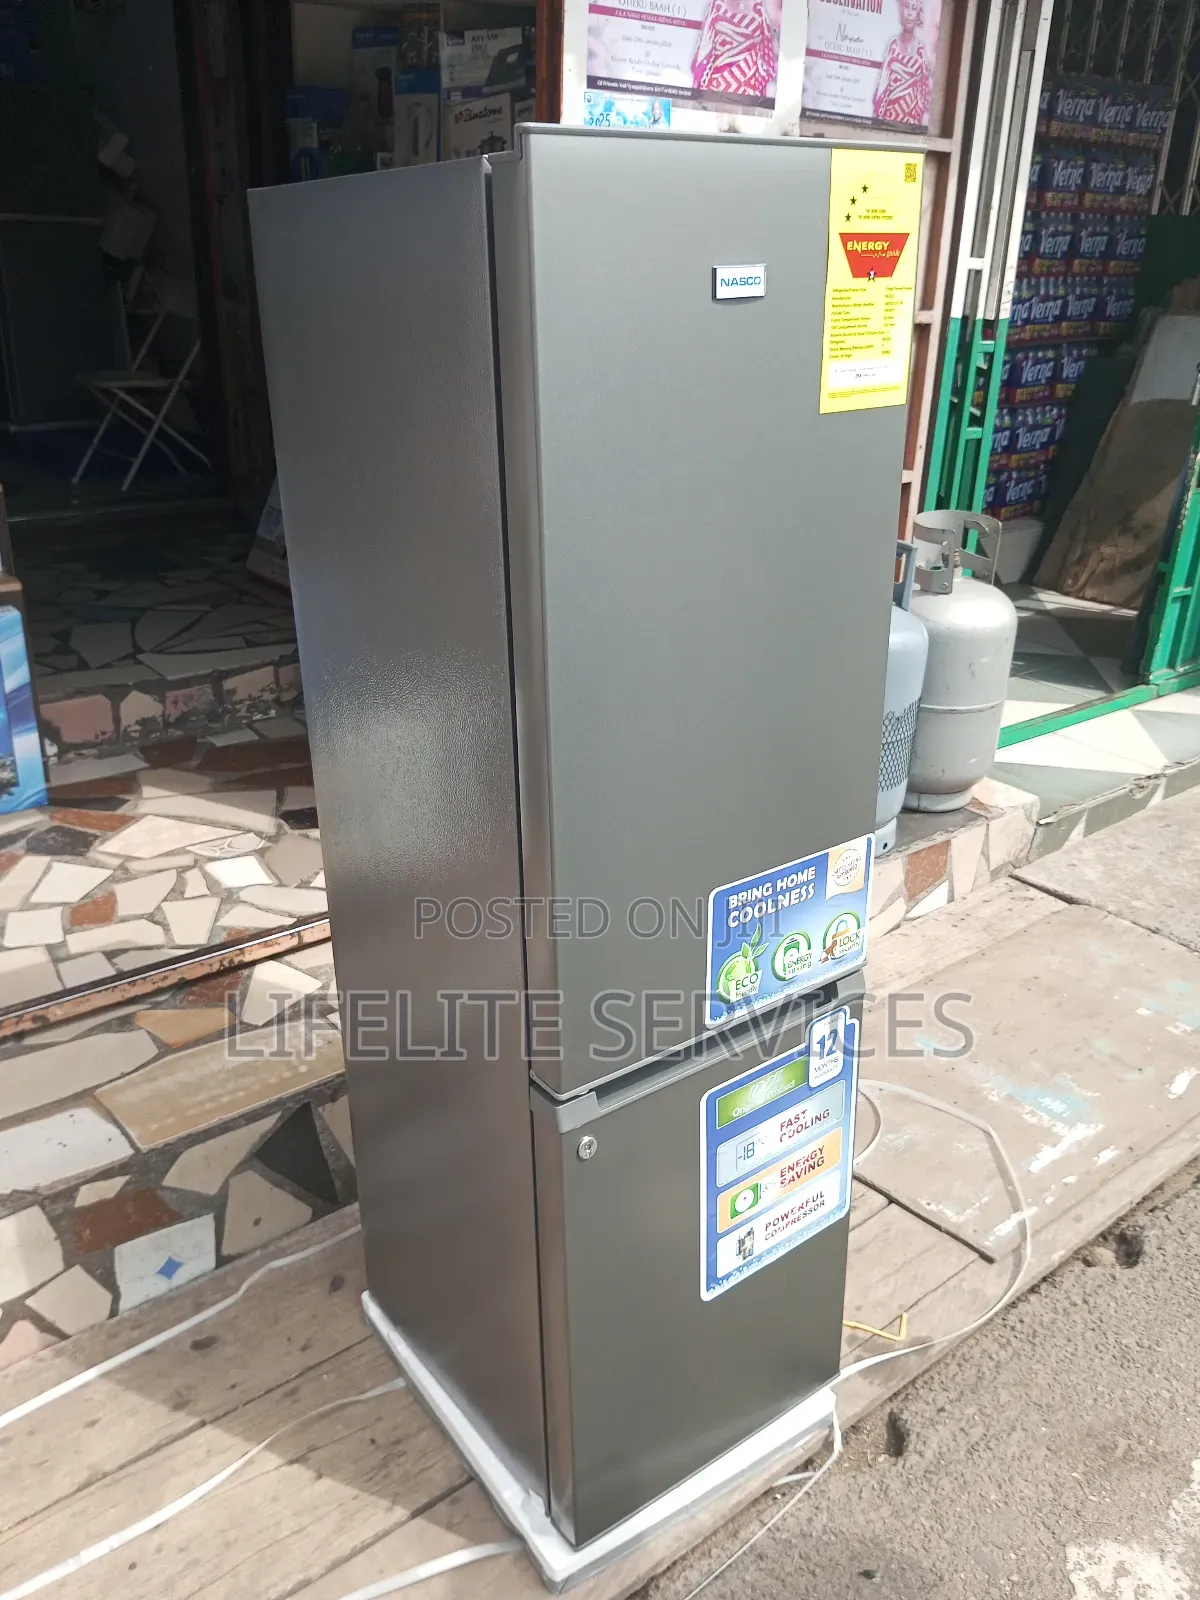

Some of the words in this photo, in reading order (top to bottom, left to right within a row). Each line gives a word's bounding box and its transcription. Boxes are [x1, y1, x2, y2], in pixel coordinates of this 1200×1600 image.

[1056, 89, 1096, 122] Verna
[847, 239, 890, 254] ENERGY
[1041, 228, 1072, 258] Verna
[720, 276, 761, 287] NASCO
[1030, 294, 1062, 323] Verna
[1068, 294, 1097, 318] Verna
[1021, 357, 1055, 385] Verna
[1016, 427, 1050, 450] Verna
[728, 882, 773, 910] BRING
[776, 866, 816, 892] HOME
[728, 882, 815, 928] COOLNESS
[838, 931, 861, 948] LOCK
[735, 973, 759, 991] ECO
[816, 1029, 838, 1060] 12
[814, 1056, 839, 1073] MONTHS
[780, 1109, 808, 1131] FAST
[780, 1108, 830, 1142] COOLING
[780, 1145, 825, 1178] ENERGY
[780, 1156, 825, 1189] SAVING
[764, 1200, 826, 1241] COMPRESSOR
[765, 1190, 825, 1232] POWERFUL
